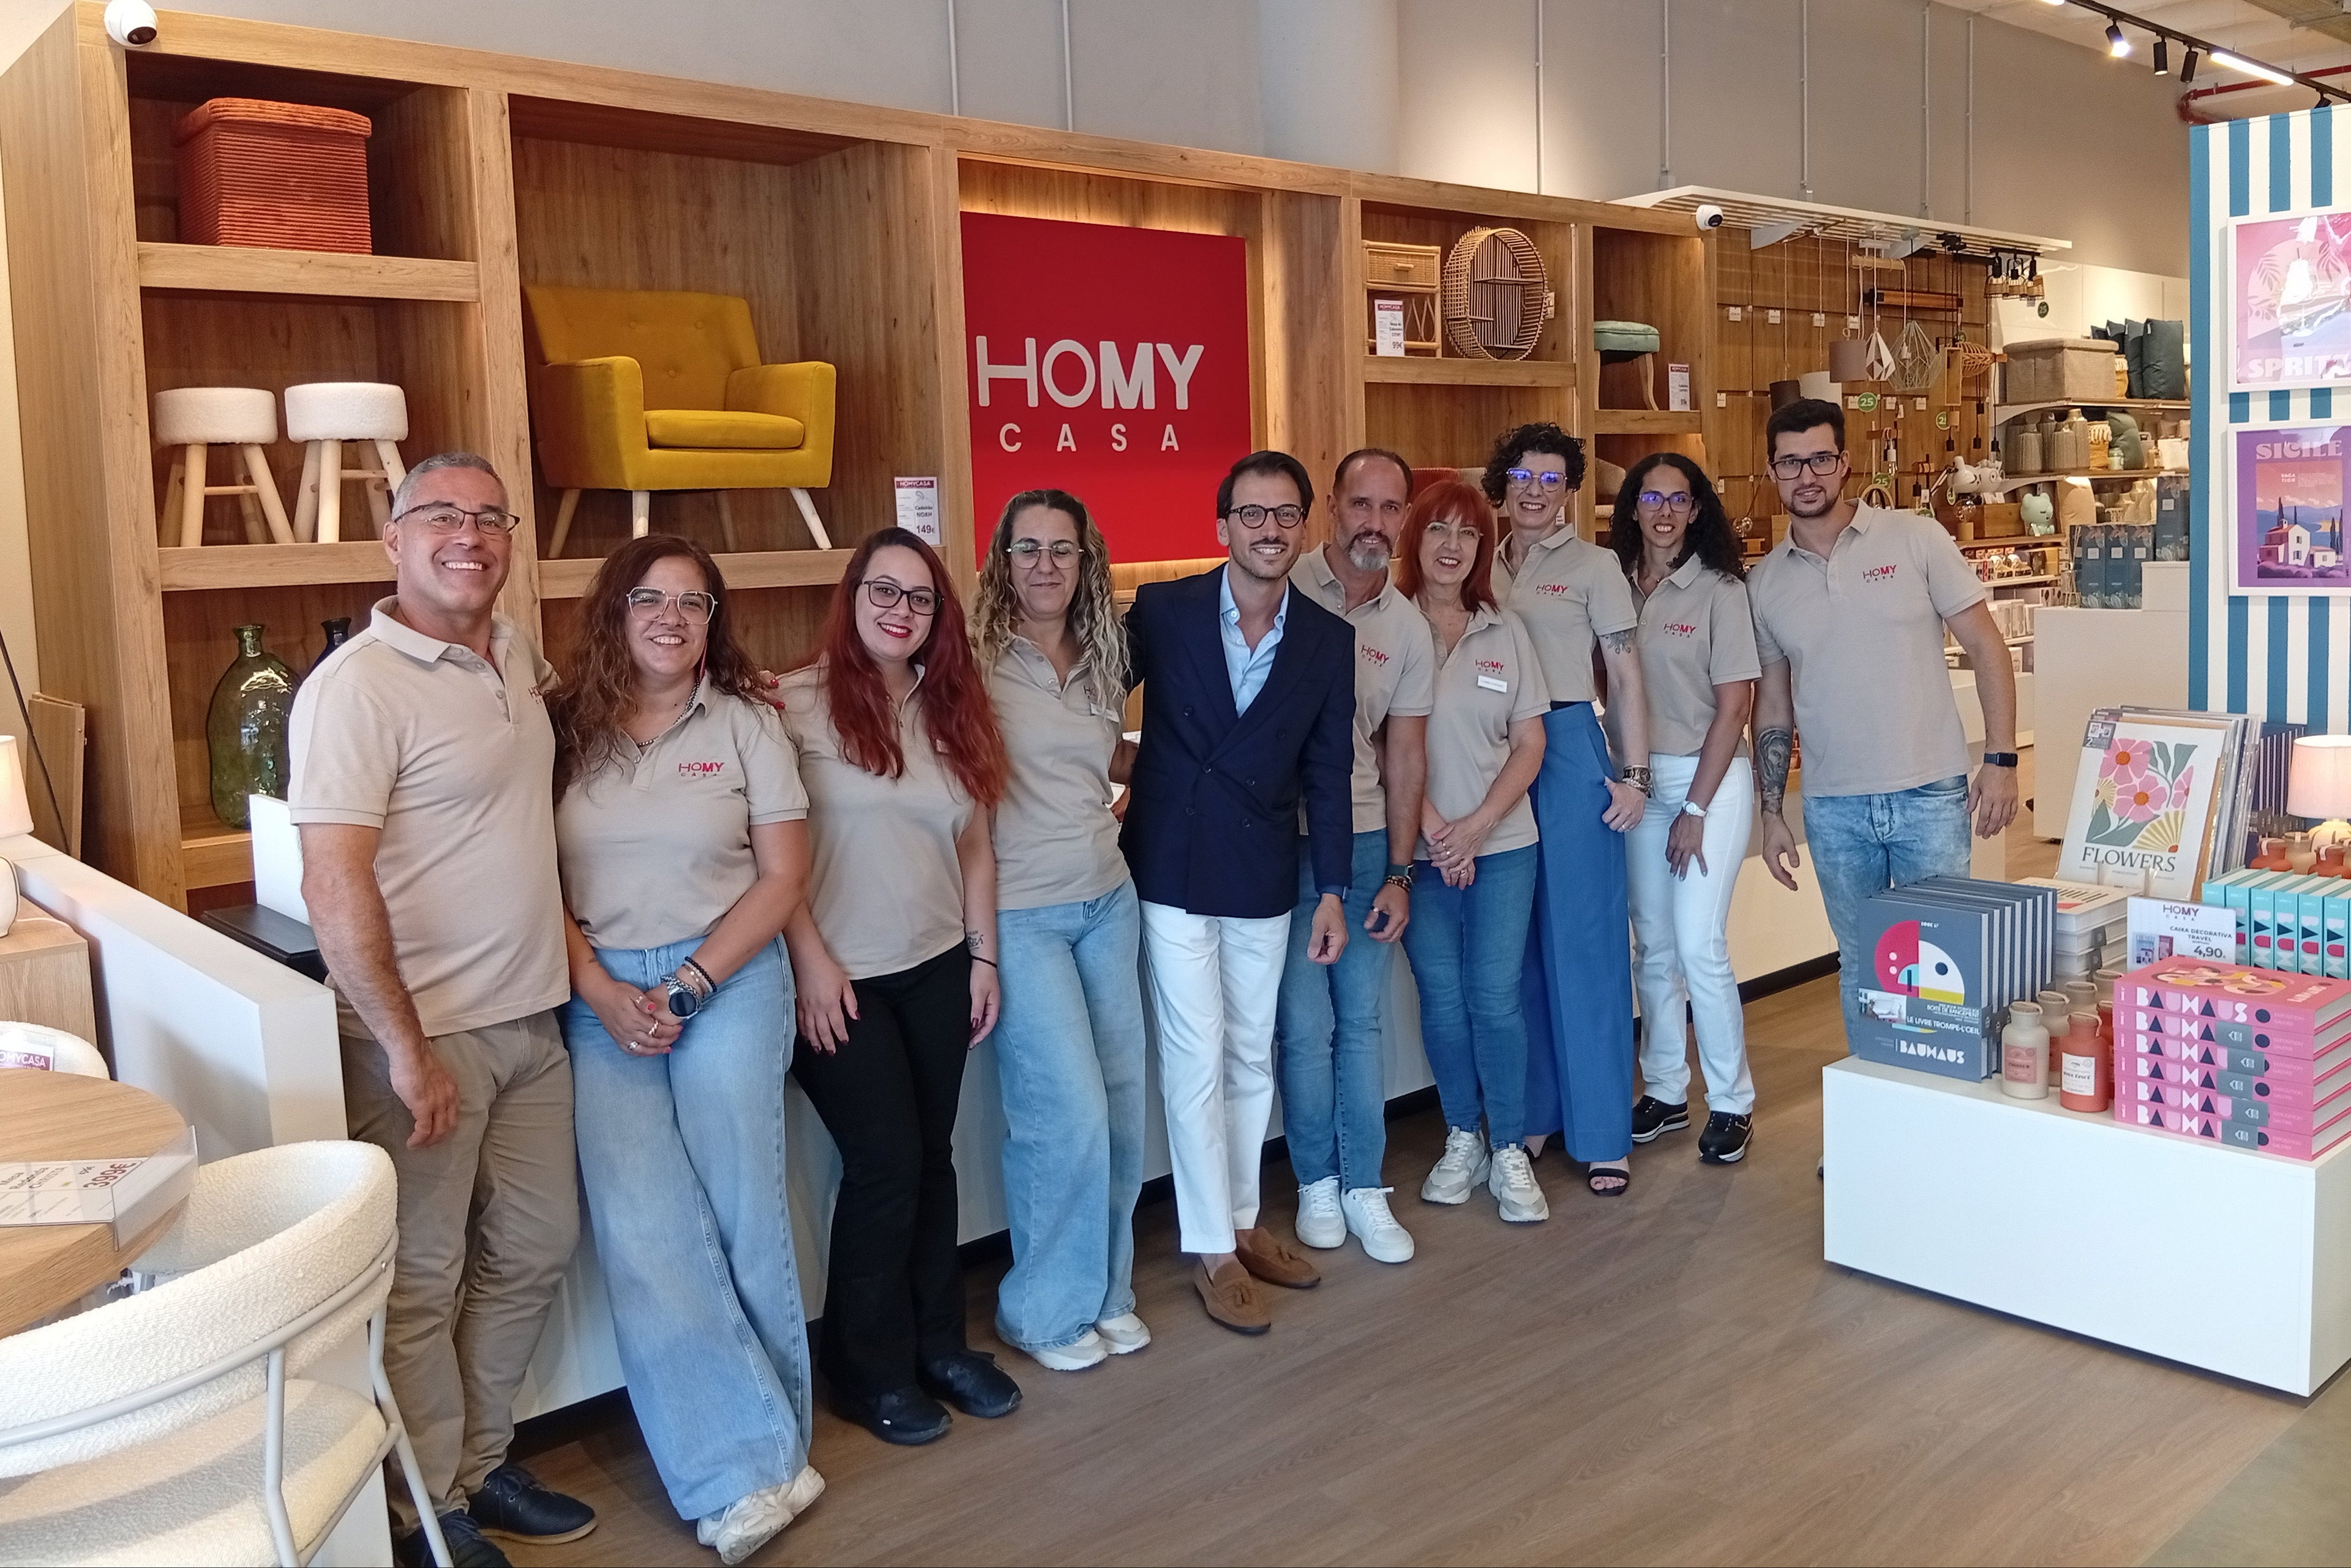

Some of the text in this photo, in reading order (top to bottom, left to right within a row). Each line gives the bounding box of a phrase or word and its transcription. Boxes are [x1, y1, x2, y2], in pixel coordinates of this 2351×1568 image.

[976, 336, 1204, 410] HOMY
[1860, 398, 1874, 407] 25
[1000, 422, 1180, 452] CASA
[2255, 440, 2342, 460] SICILE
[917, 525, 936, 534] 149€
[1862, 565, 1897, 579] HOMY
[1535, 584, 1568, 594] HOMY
[1663, 623, 1697, 634] HOMY
[1361, 644, 1390, 664] HOMY
[1475, 659, 1504, 671] HOMY
[678, 762, 725, 772] HOMY
[2082, 846, 2176, 872] FLOWERS
[2162, 904, 2199, 917] HOMY
[2191, 929, 2232, 939] DECORATIVA
[1914, 1018, 1932, 1027] LIVRE
[1900, 1040, 1965, 1064] BAUHAUS
[0, 1051, 46, 1068] OMYCASA
[83, 1163, 138, 1188] 399€
